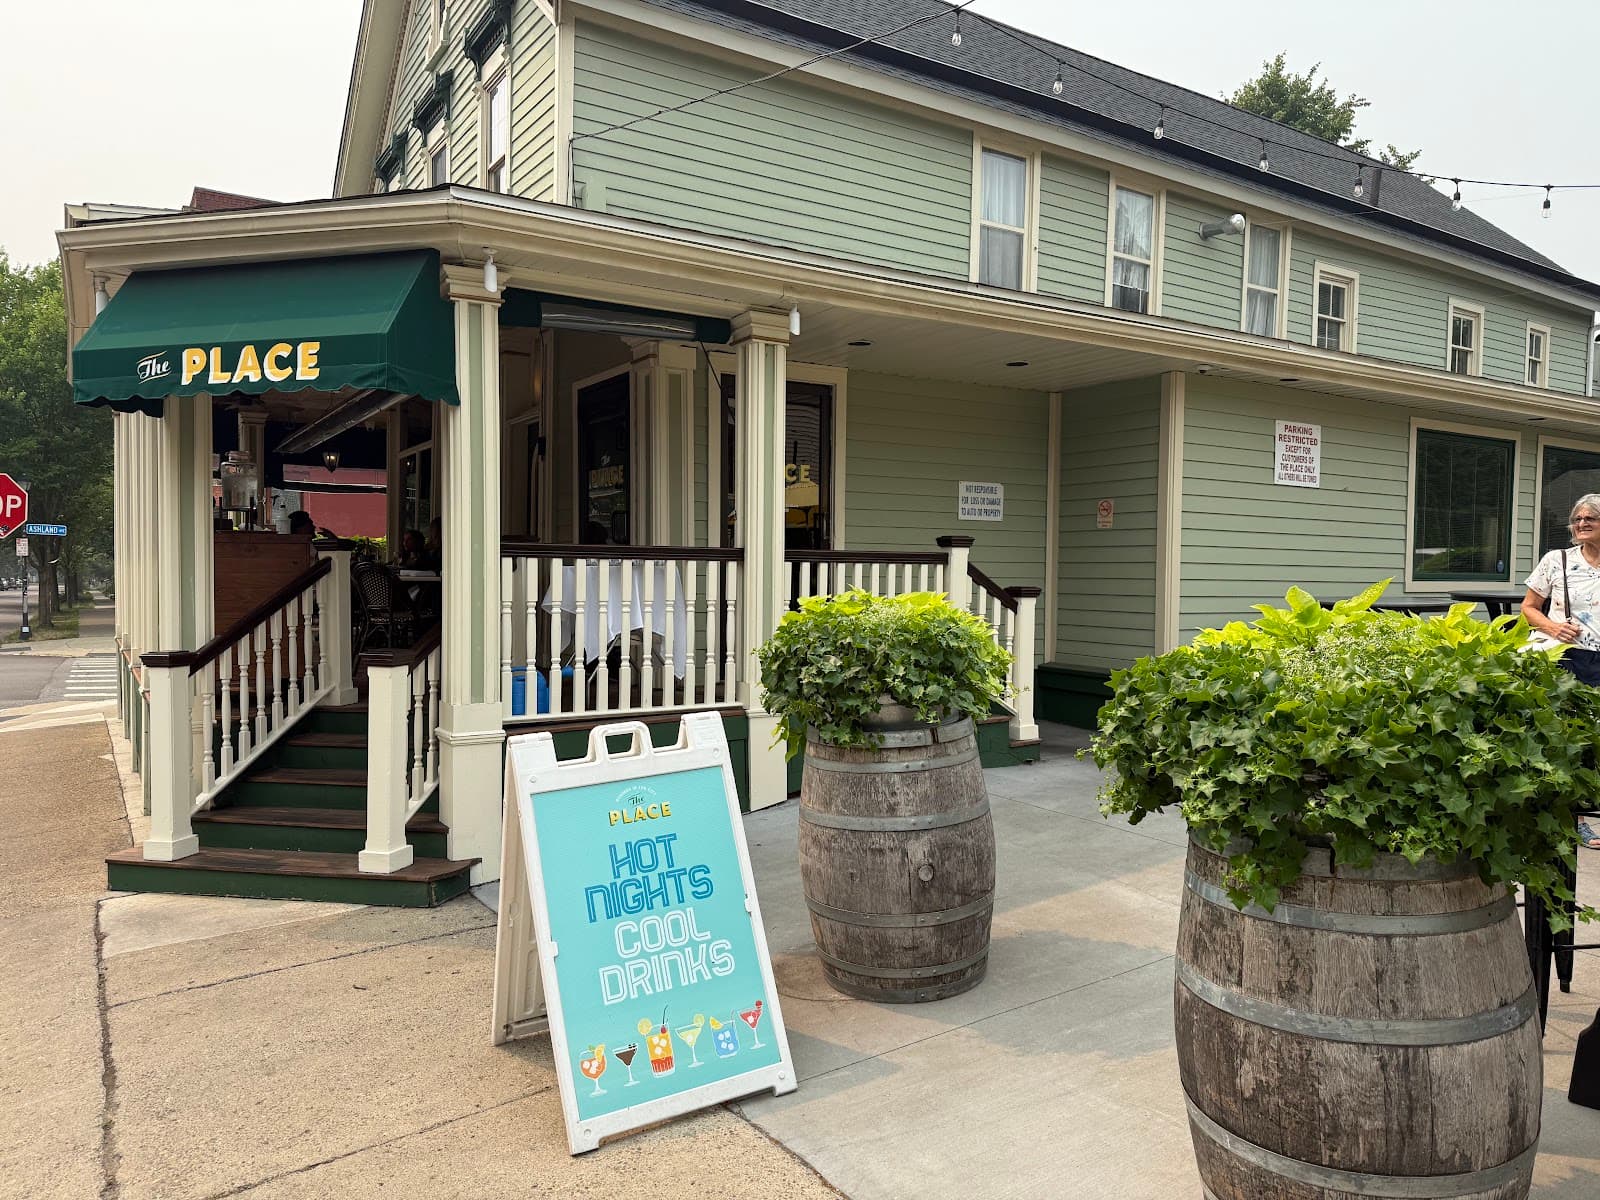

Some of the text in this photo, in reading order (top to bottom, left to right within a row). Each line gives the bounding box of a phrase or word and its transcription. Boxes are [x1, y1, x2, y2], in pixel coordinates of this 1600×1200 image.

[137, 341, 321, 386] The PLACE
[1278, 434, 1318, 446] RESTRICTED
[1284, 424, 1313, 436] PARKING
[1281, 453, 1315, 465] CUSTOMERS OF
[1285, 444, 1312, 455] EXCEPT FOR
[1280, 463, 1289, 472] THE
[1289, 463, 1303, 473] PLACE
[0, 494, 22, 518] P
[28, 524, 58, 534] ASHLAND
[608, 800, 672, 827] PLACE
[608, 832, 677, 879] HOT
[584, 864, 714, 924] NIGHTS
[614, 907, 711, 959] COOL
[598, 939, 736, 1006] DRINKS
